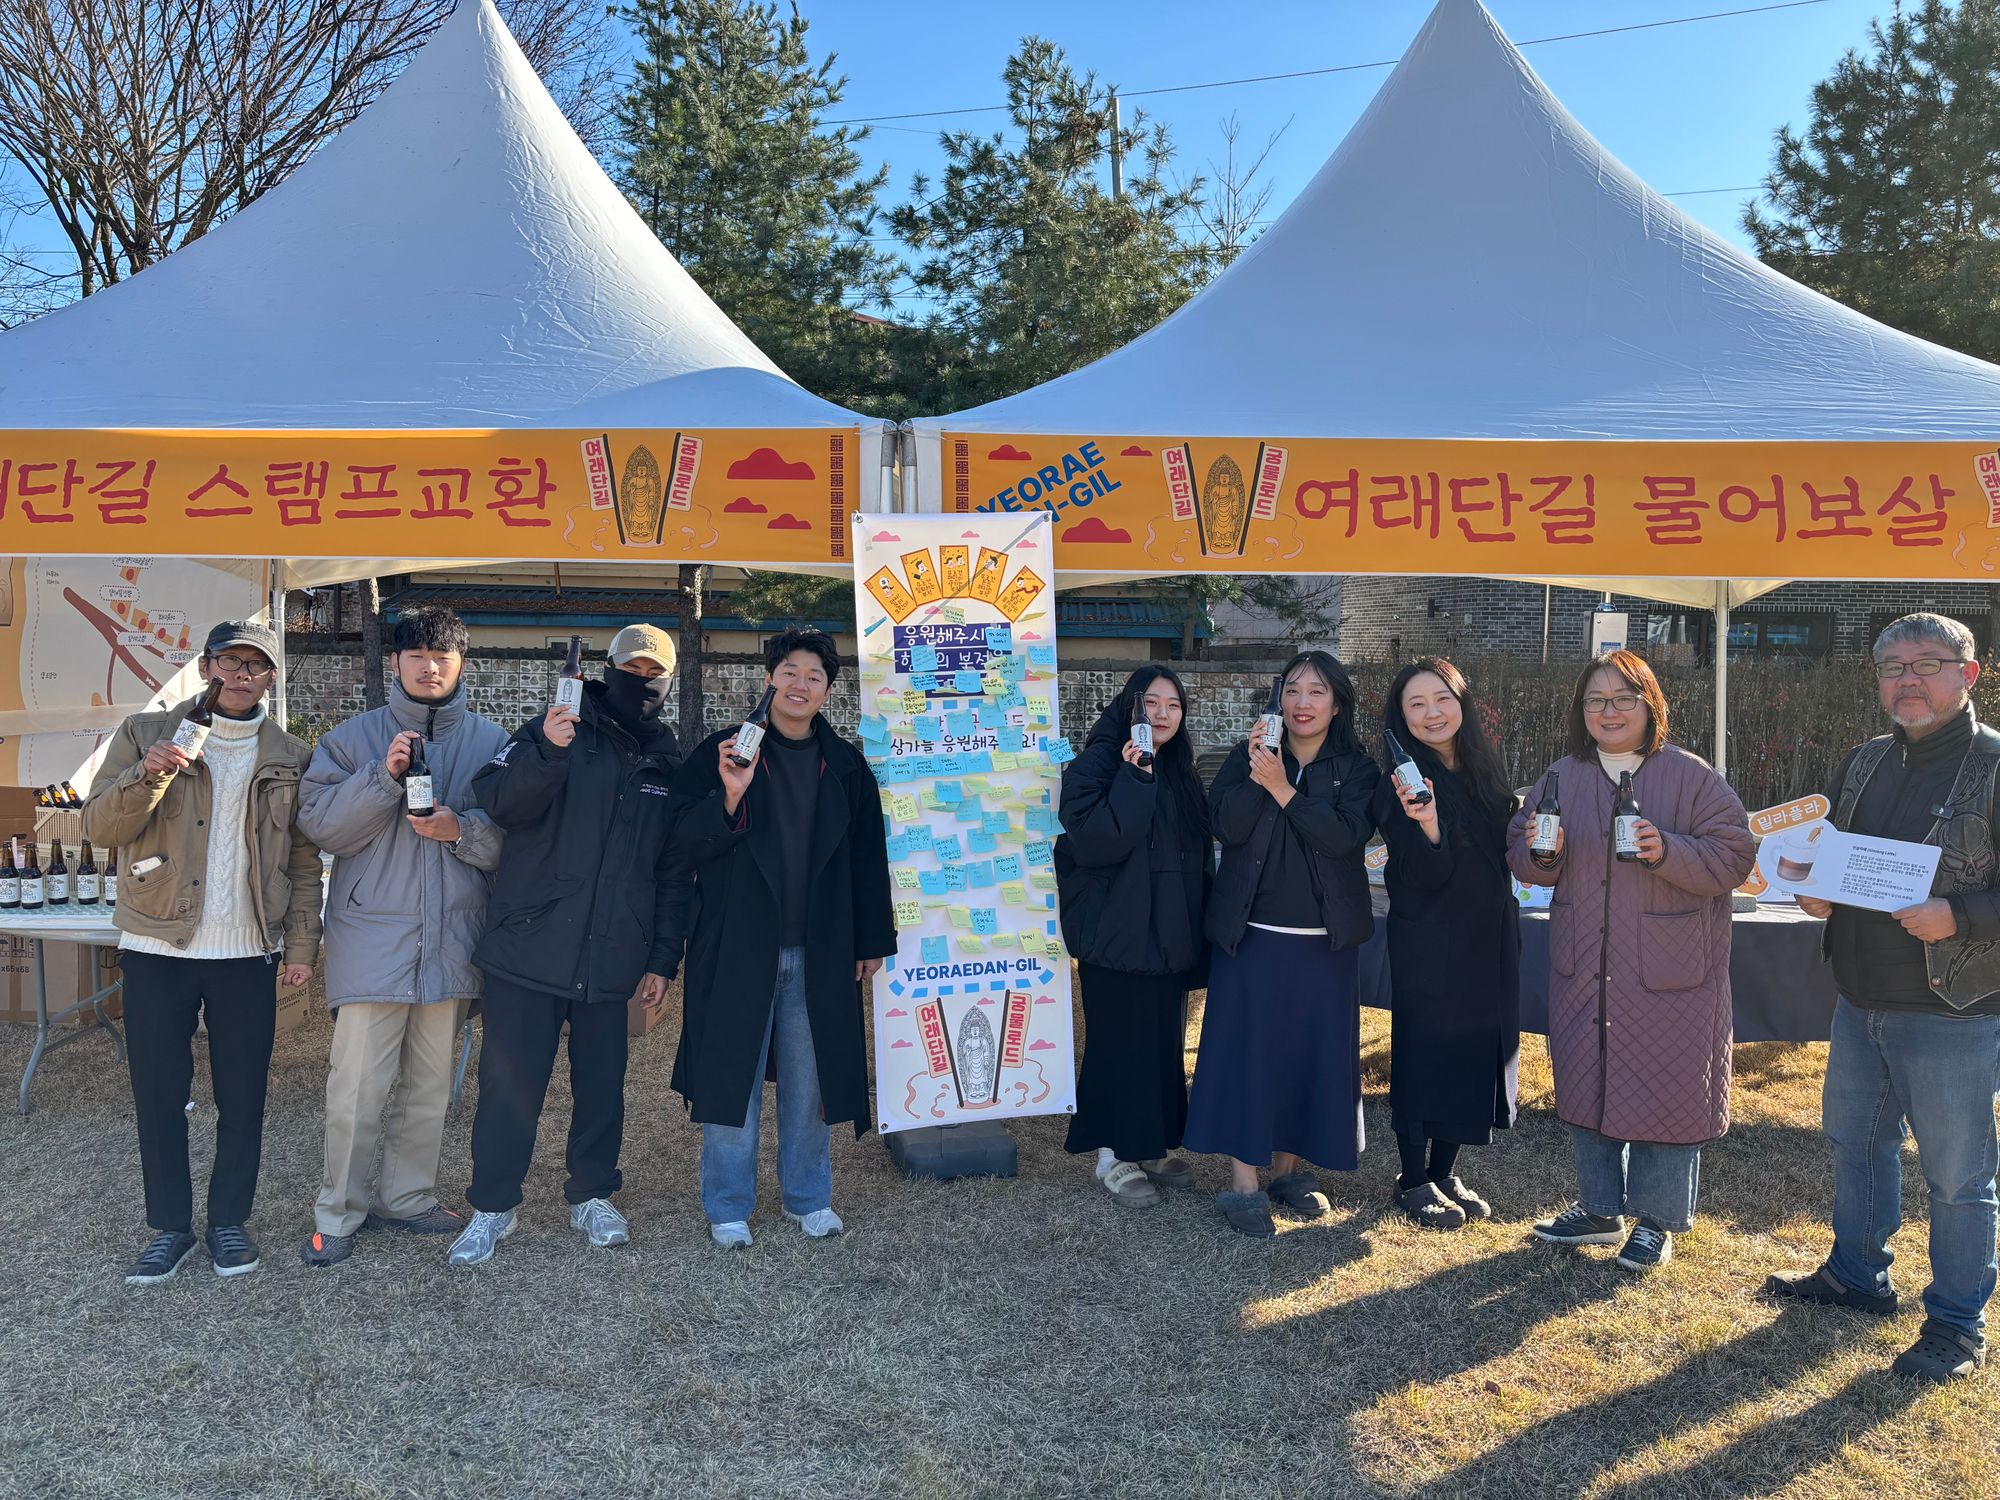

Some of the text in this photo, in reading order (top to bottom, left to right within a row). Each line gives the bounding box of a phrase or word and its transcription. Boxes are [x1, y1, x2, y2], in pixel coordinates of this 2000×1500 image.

[185, 458, 558, 528] 스탬프교환
[585, 439, 611, 508] 여래단길
[975, 441, 1106, 513] YEORAE
[1165, 448, 1194, 518] 여래단길
[1295, 469, 1956, 548] 여래단길 물어보살
[903, 625, 1001, 646] 응원해주시
[942, 733, 1036, 751] 응원해주요!
[904, 957, 1042, 982] YEORAEDAN-GIL
[920, 1005, 948, 1073] 여래단길
